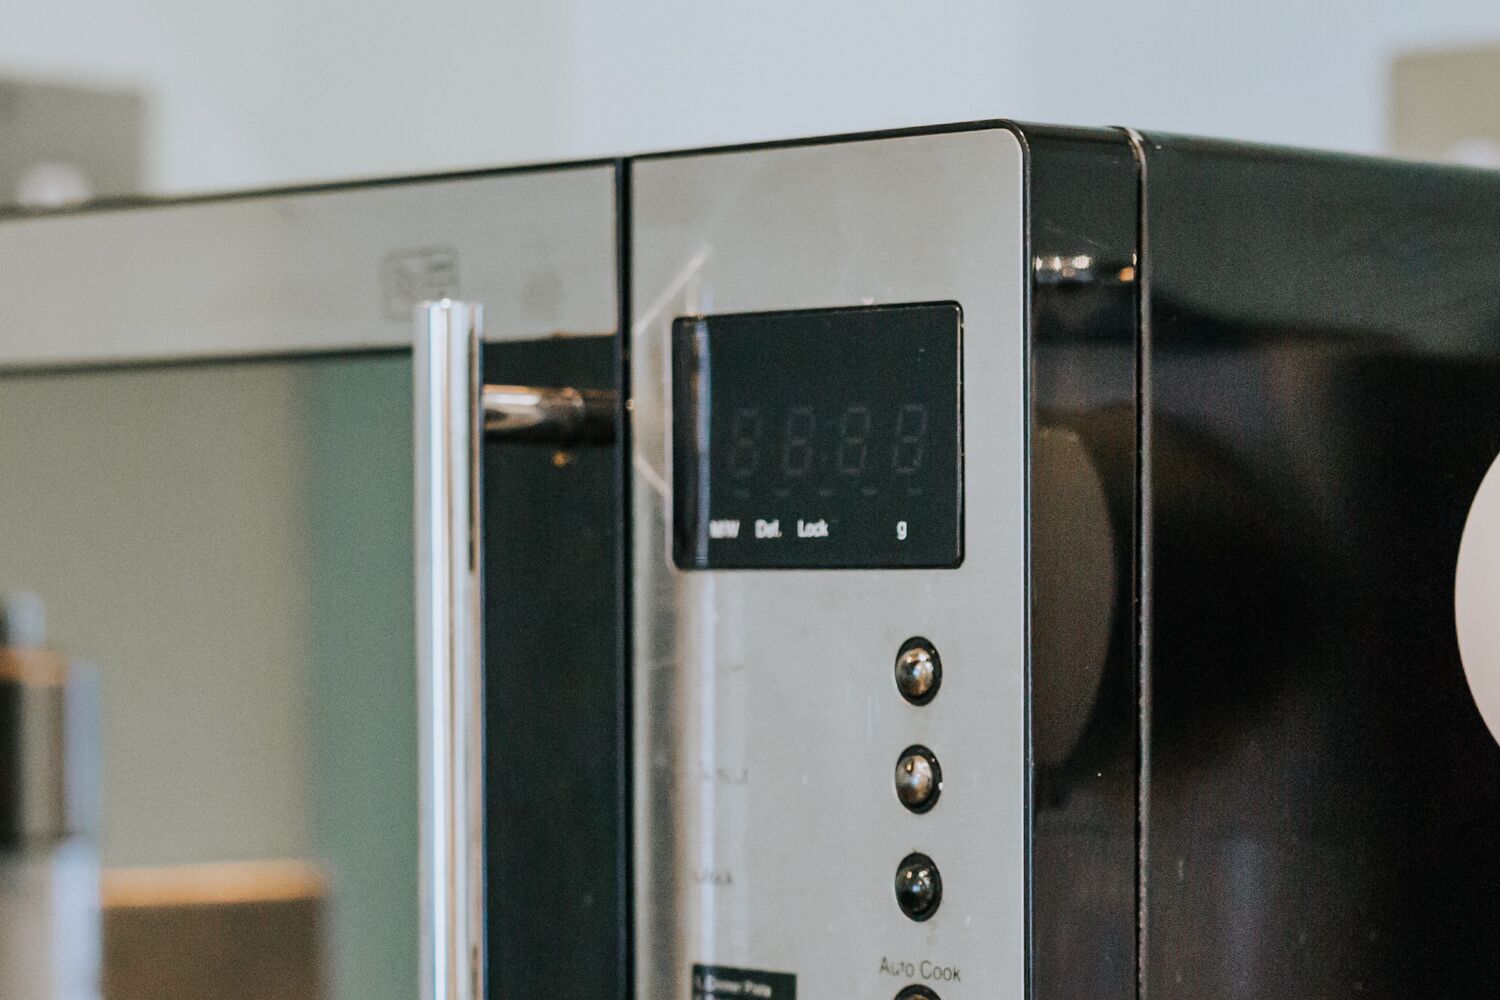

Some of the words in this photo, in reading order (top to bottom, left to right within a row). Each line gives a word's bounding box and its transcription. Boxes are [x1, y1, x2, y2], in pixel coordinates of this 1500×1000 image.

[796, 518, 829, 538] Lock
[896, 520, 908, 541] g
[920, 959, 961, 983] Cook
